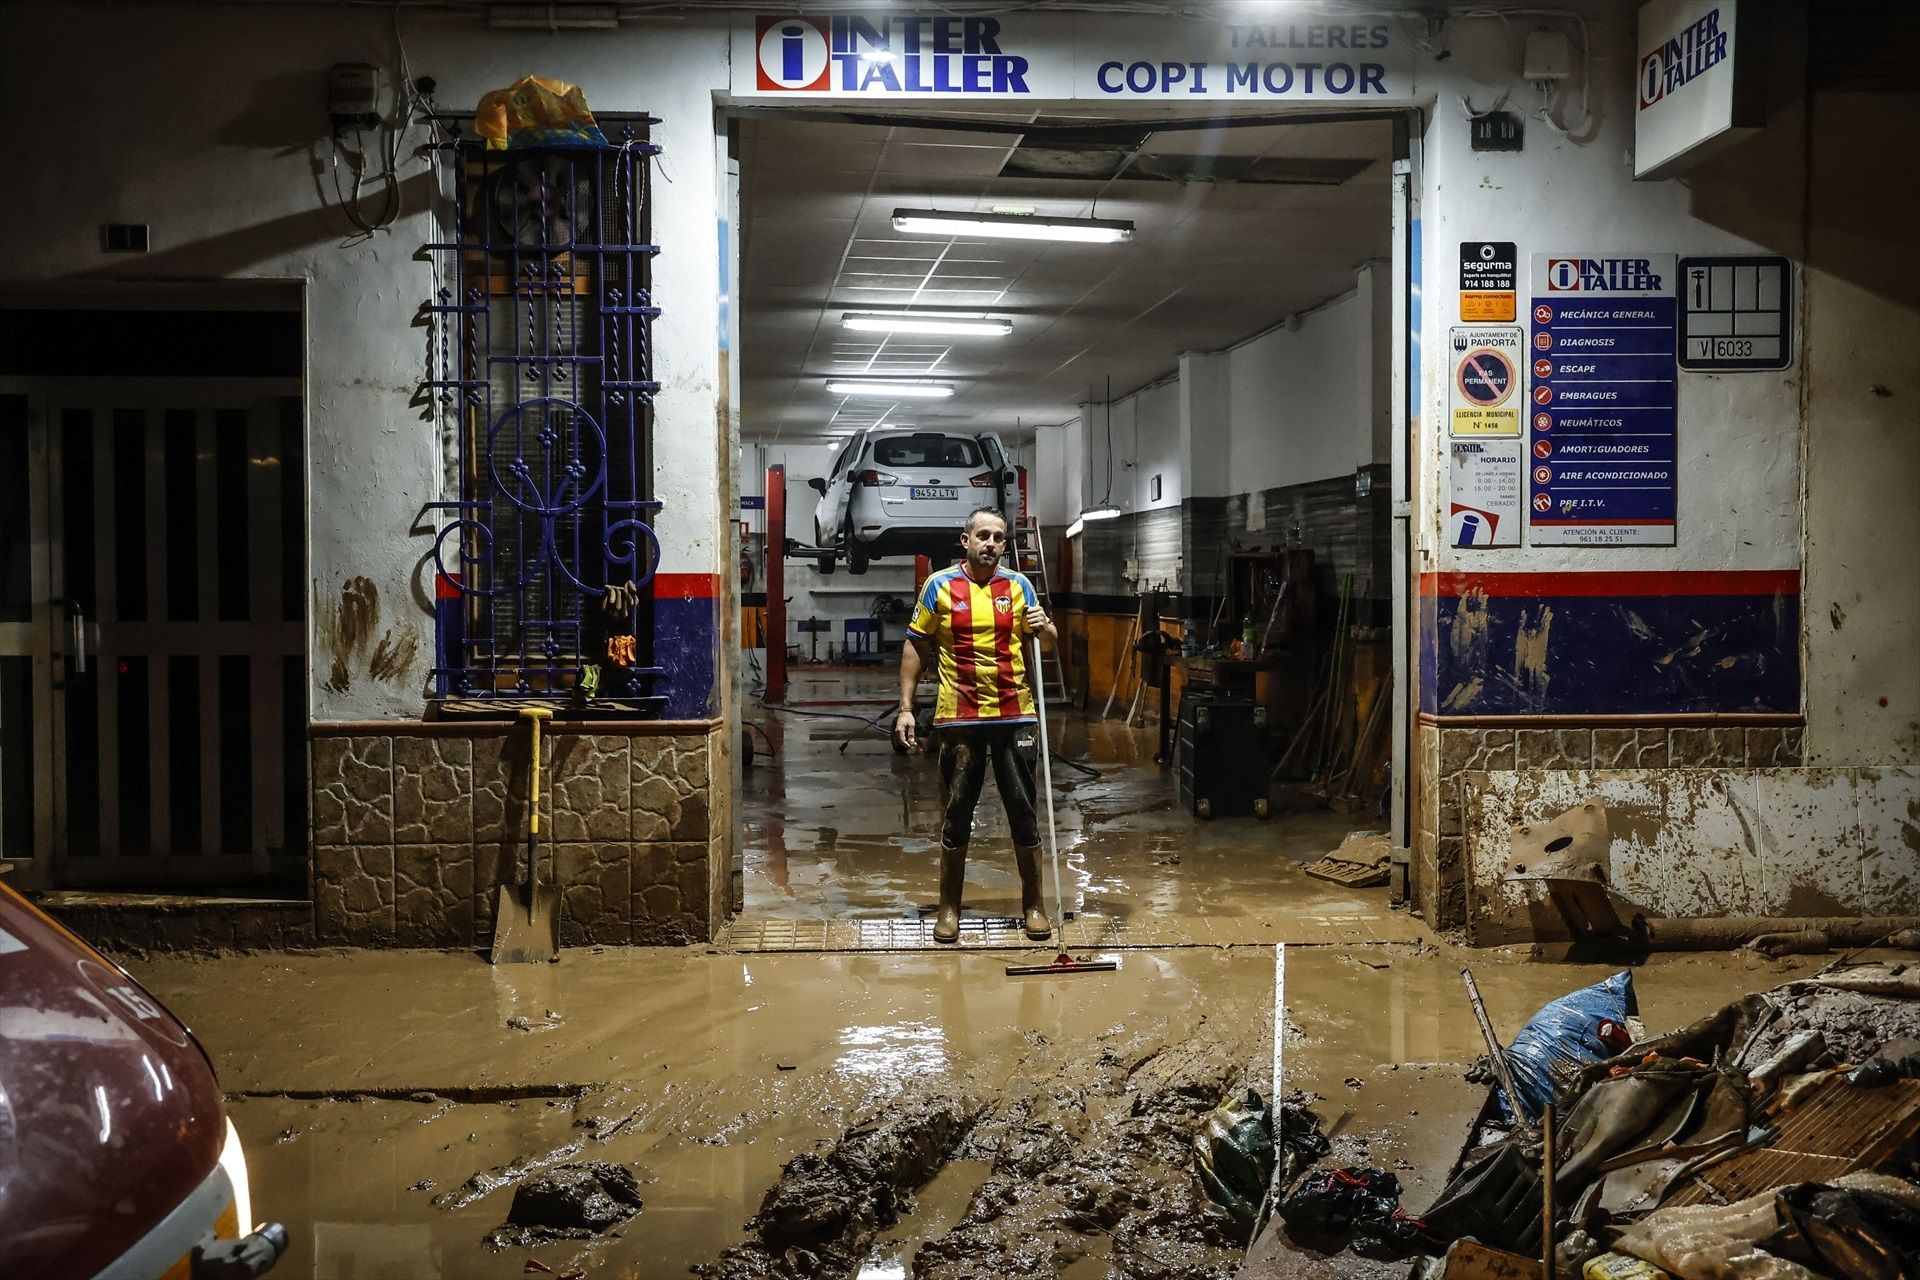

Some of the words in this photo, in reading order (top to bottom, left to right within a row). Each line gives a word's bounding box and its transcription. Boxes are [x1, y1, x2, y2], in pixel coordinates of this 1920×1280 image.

[832, 16, 1003, 55] INTER
[1224, 24, 1389, 49] TALLERES
[1664, 8, 1720, 70] INTER
[1664, 31, 1728, 96] TALLER
[832, 54, 1031, 92] TALLER
[1097, 61, 1208, 94] COPI
[1226, 61, 1389, 94] MOTOR
[1463, 261, 1512, 272] segurma
[1580, 259, 1651, 275] INTER
[1465, 280, 1479, 288] 914
[1481, 280, 1495, 288] 188
[1497, 280, 1510, 288] 188
[1580, 274, 1662, 291] TALLER
[1560, 309, 1610, 319] MECÁNICA
[1612, 310, 1656, 319] GENERAL
[1560, 338, 1615, 347] DIAGNOSIS
[1700, 340, 1709, 357] V
[1717, 340, 1752, 357] 6033
[1559, 365, 1597, 373] ESCAPE
[1559, 392, 1618, 400] EMBRAGUES
[1559, 417, 1622, 427] NEUMÁTICOS
[1559, 445, 1650, 454] AMORTIGUADORES
[1559, 472, 1583, 480] AIRE
[1584, 471, 1669, 480] ACONDICIONADO
[915, 489, 937, 497] 9452
[939, 489, 955, 497] LTV
[1560, 500, 1578, 508] PRE
[1580, 499, 1605, 507] I.T.V.
[1563, 527, 1597, 536] ATENCIÓN
[104, 986, 161, 1020] 15
